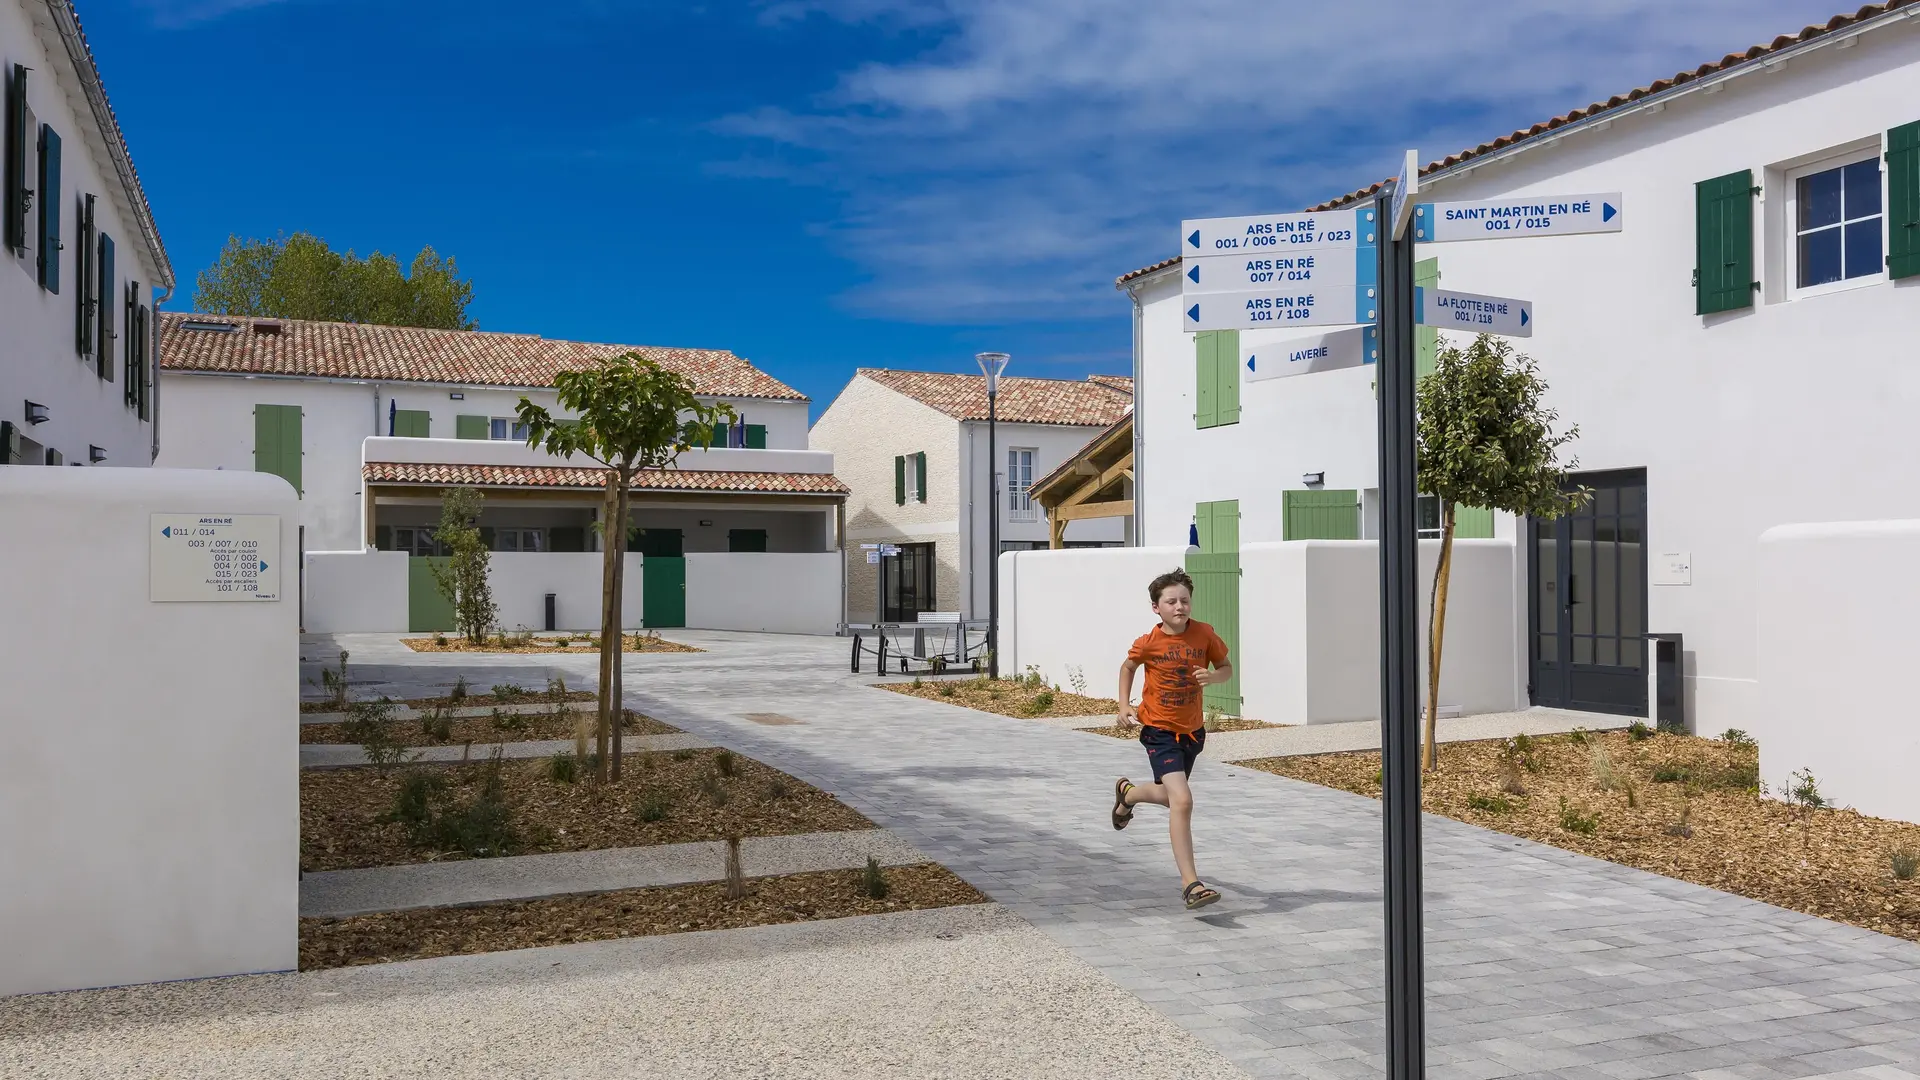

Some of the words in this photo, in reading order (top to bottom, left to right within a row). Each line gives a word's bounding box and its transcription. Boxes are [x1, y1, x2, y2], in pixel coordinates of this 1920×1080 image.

[1445, 208, 1487, 220] SAINT
[1491, 205, 1545, 218] MARTIN
[1549, 203, 1568, 215] EN
[1572, 200, 1591, 213] RÉ
[1246, 223, 1273, 235] ARS
[1276, 222, 1294, 233] EN
[1298, 218, 1315, 231] RÉ
[1485, 219, 1511, 231] 001
[1515, 219, 1522, 229] /
[1525, 217, 1551, 228] 015
[1215, 238, 1239, 249] 001
[1242, 237, 1249, 247] /
[1252, 235, 1277, 246] 006
[1290, 233, 1313, 244] 015
[1317, 232, 1324, 242] /
[1327, 230, 1351, 241] 023
[1246, 260, 1272, 272] ARS
[1275, 259, 1293, 270] EN
[1297, 256, 1315, 269] RÉ
[1250, 272, 1274, 283] 007
[1278, 271, 1284, 281] /
[1287, 270, 1311, 281] 014
[1246, 298, 1272, 310] ARS
[1275, 297, 1293, 308] EN
[1297, 294, 1315, 307] RÉ
[1437, 296, 1449, 308] LA
[1450, 298, 1482, 312] FLOTTE
[1484, 302, 1496, 314] EN
[1497, 303, 1508, 315] RÉ
[1250, 310, 1273, 322] 101
[1277, 309, 1283, 320] /
[1286, 308, 1310, 319] 108
[1455, 311, 1470, 322] 001
[1472, 312, 1477, 323] /
[1478, 313, 1493, 325] 118
[1290, 346, 1328, 362] LAVERIE
[173, 528, 189, 536] 011
[199, 528, 215, 536] 014
[188, 540, 205, 548] 003
[215, 540, 231, 548] 007
[241, 540, 258, 548] 010
[214, 554, 231, 562] 001
[241, 554, 258, 562] 002
[213, 562, 230, 570] 004
[240, 562, 258, 570] 006
[215, 570, 232, 578] 015
[241, 570, 258, 578] 023
[217, 584, 233, 592] 101
[243, 584, 258, 592] 108
